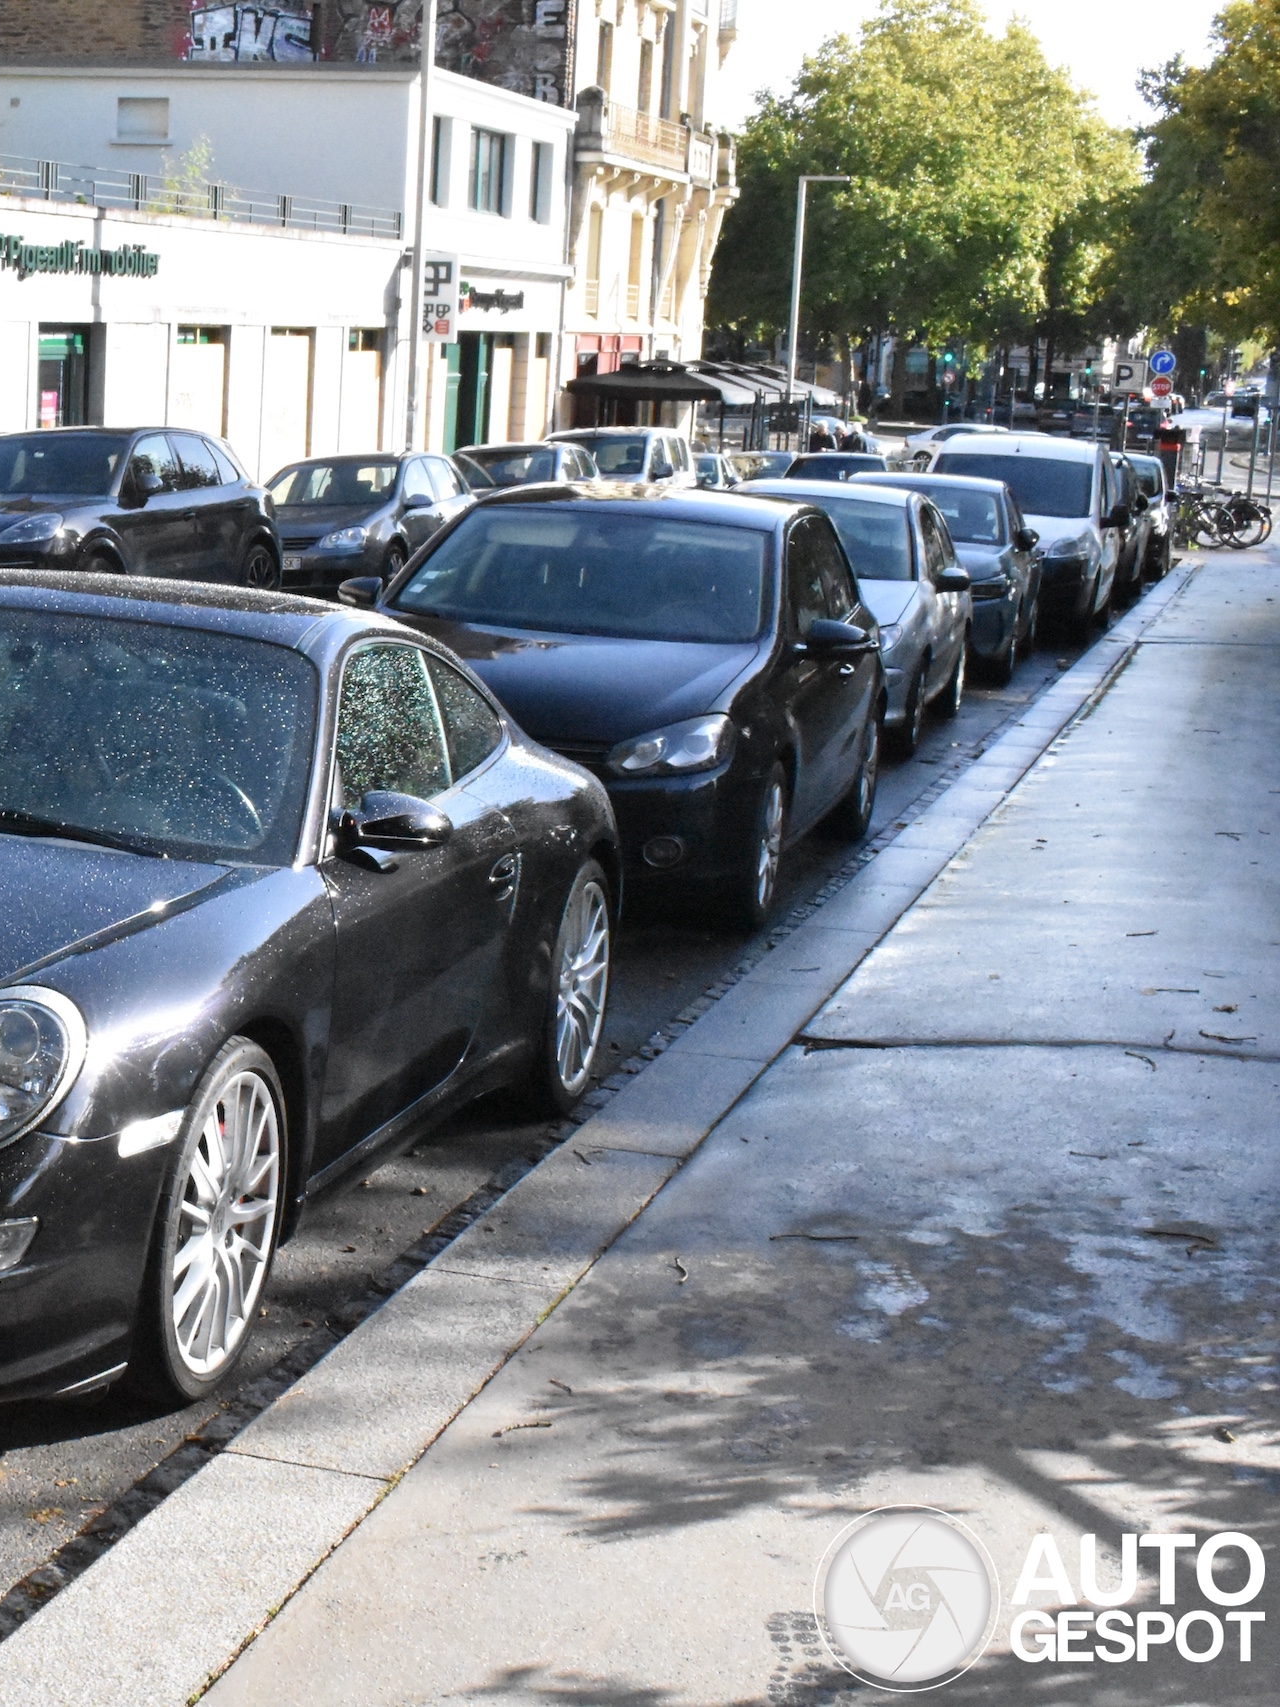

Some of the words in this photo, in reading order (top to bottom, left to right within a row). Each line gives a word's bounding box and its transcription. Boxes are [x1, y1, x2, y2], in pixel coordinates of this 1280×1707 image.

[8, 235, 79, 278] Pigeault
[81, 240, 160, 277] immobilier
[1115, 364, 1133, 387] P
[1152, 383, 1171, 391] STOP
